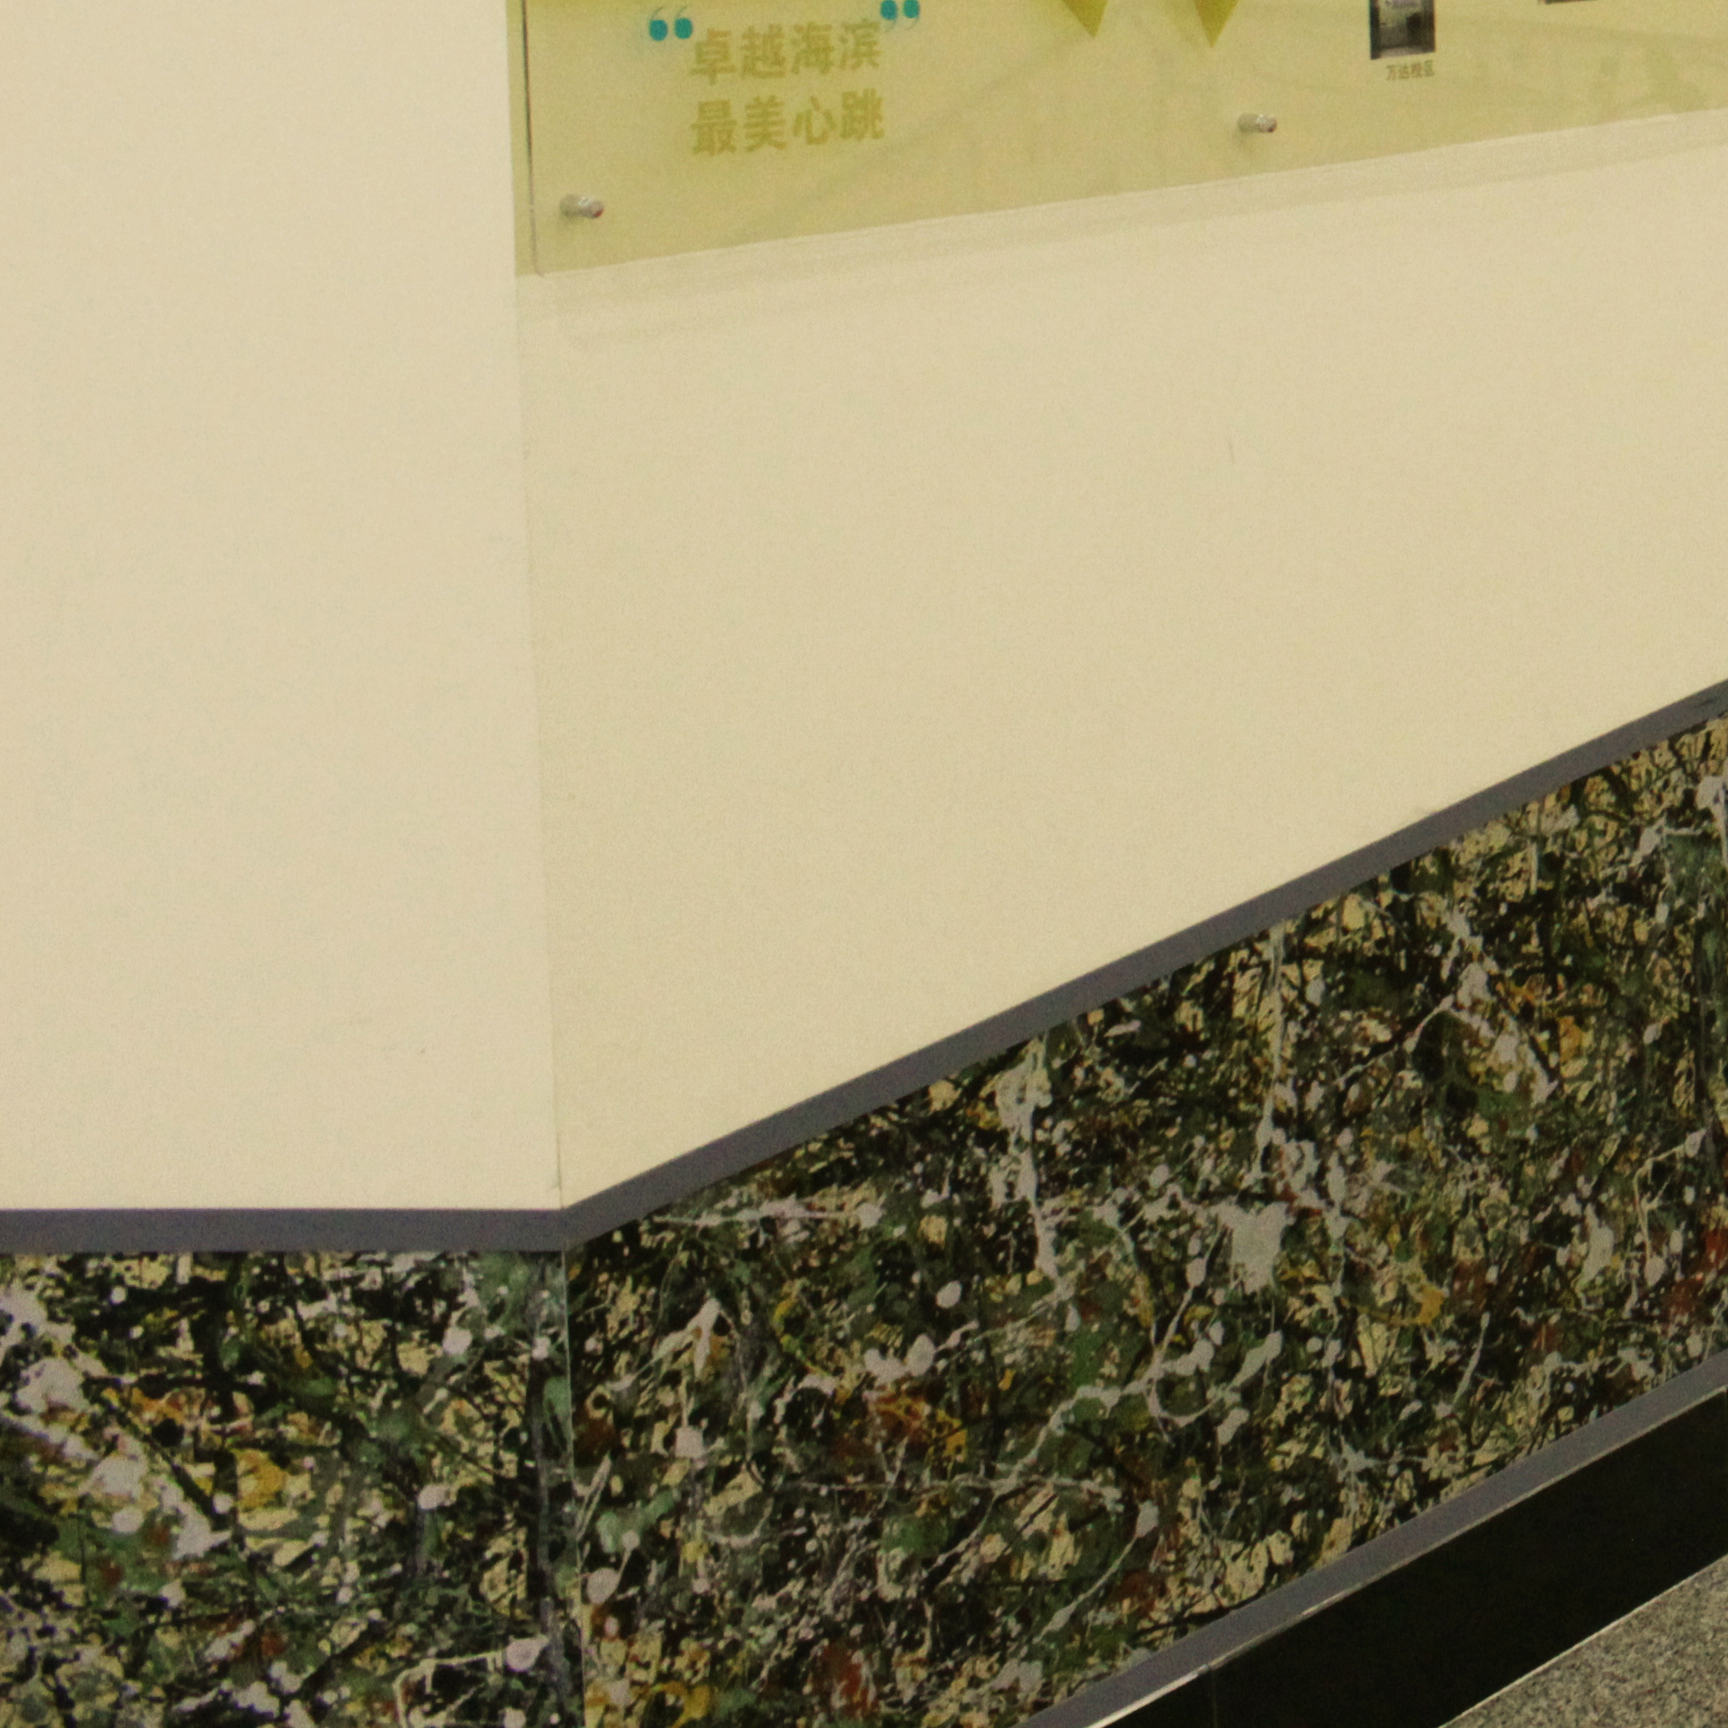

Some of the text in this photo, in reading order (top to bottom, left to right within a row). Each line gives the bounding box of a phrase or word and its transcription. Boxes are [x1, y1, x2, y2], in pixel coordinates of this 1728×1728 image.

[691, 20, 881, 84] 卓越海滨
[690, 88, 886, 156] 最美心跳
